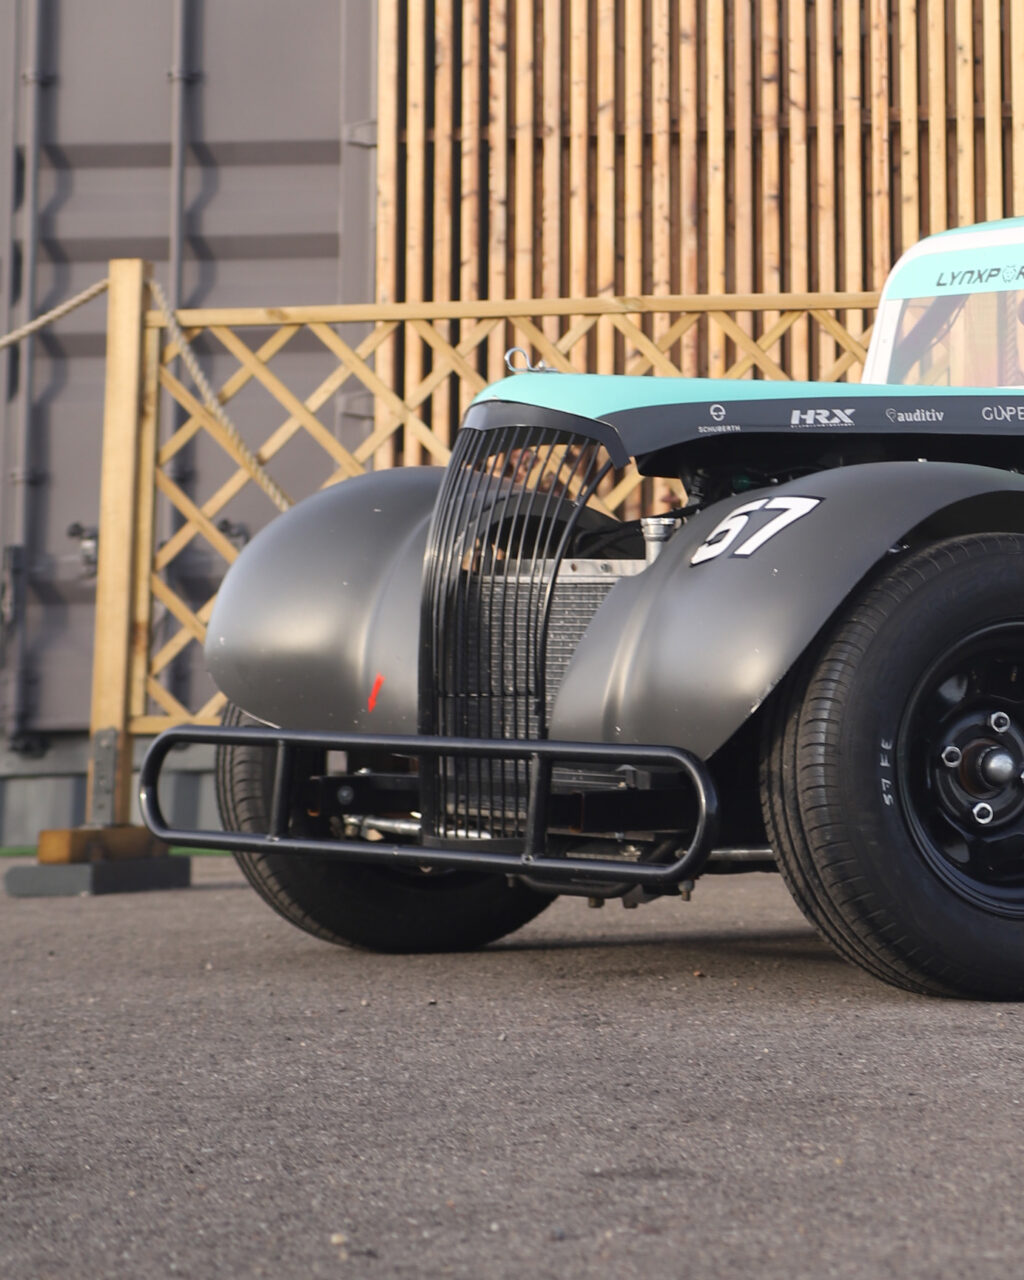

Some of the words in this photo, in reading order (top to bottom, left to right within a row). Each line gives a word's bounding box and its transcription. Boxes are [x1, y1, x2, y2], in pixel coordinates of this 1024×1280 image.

[790, 408, 856, 425] HRX
[897, 408, 944, 423] auditiv
[698, 425, 741, 433] SCHUBERTH
